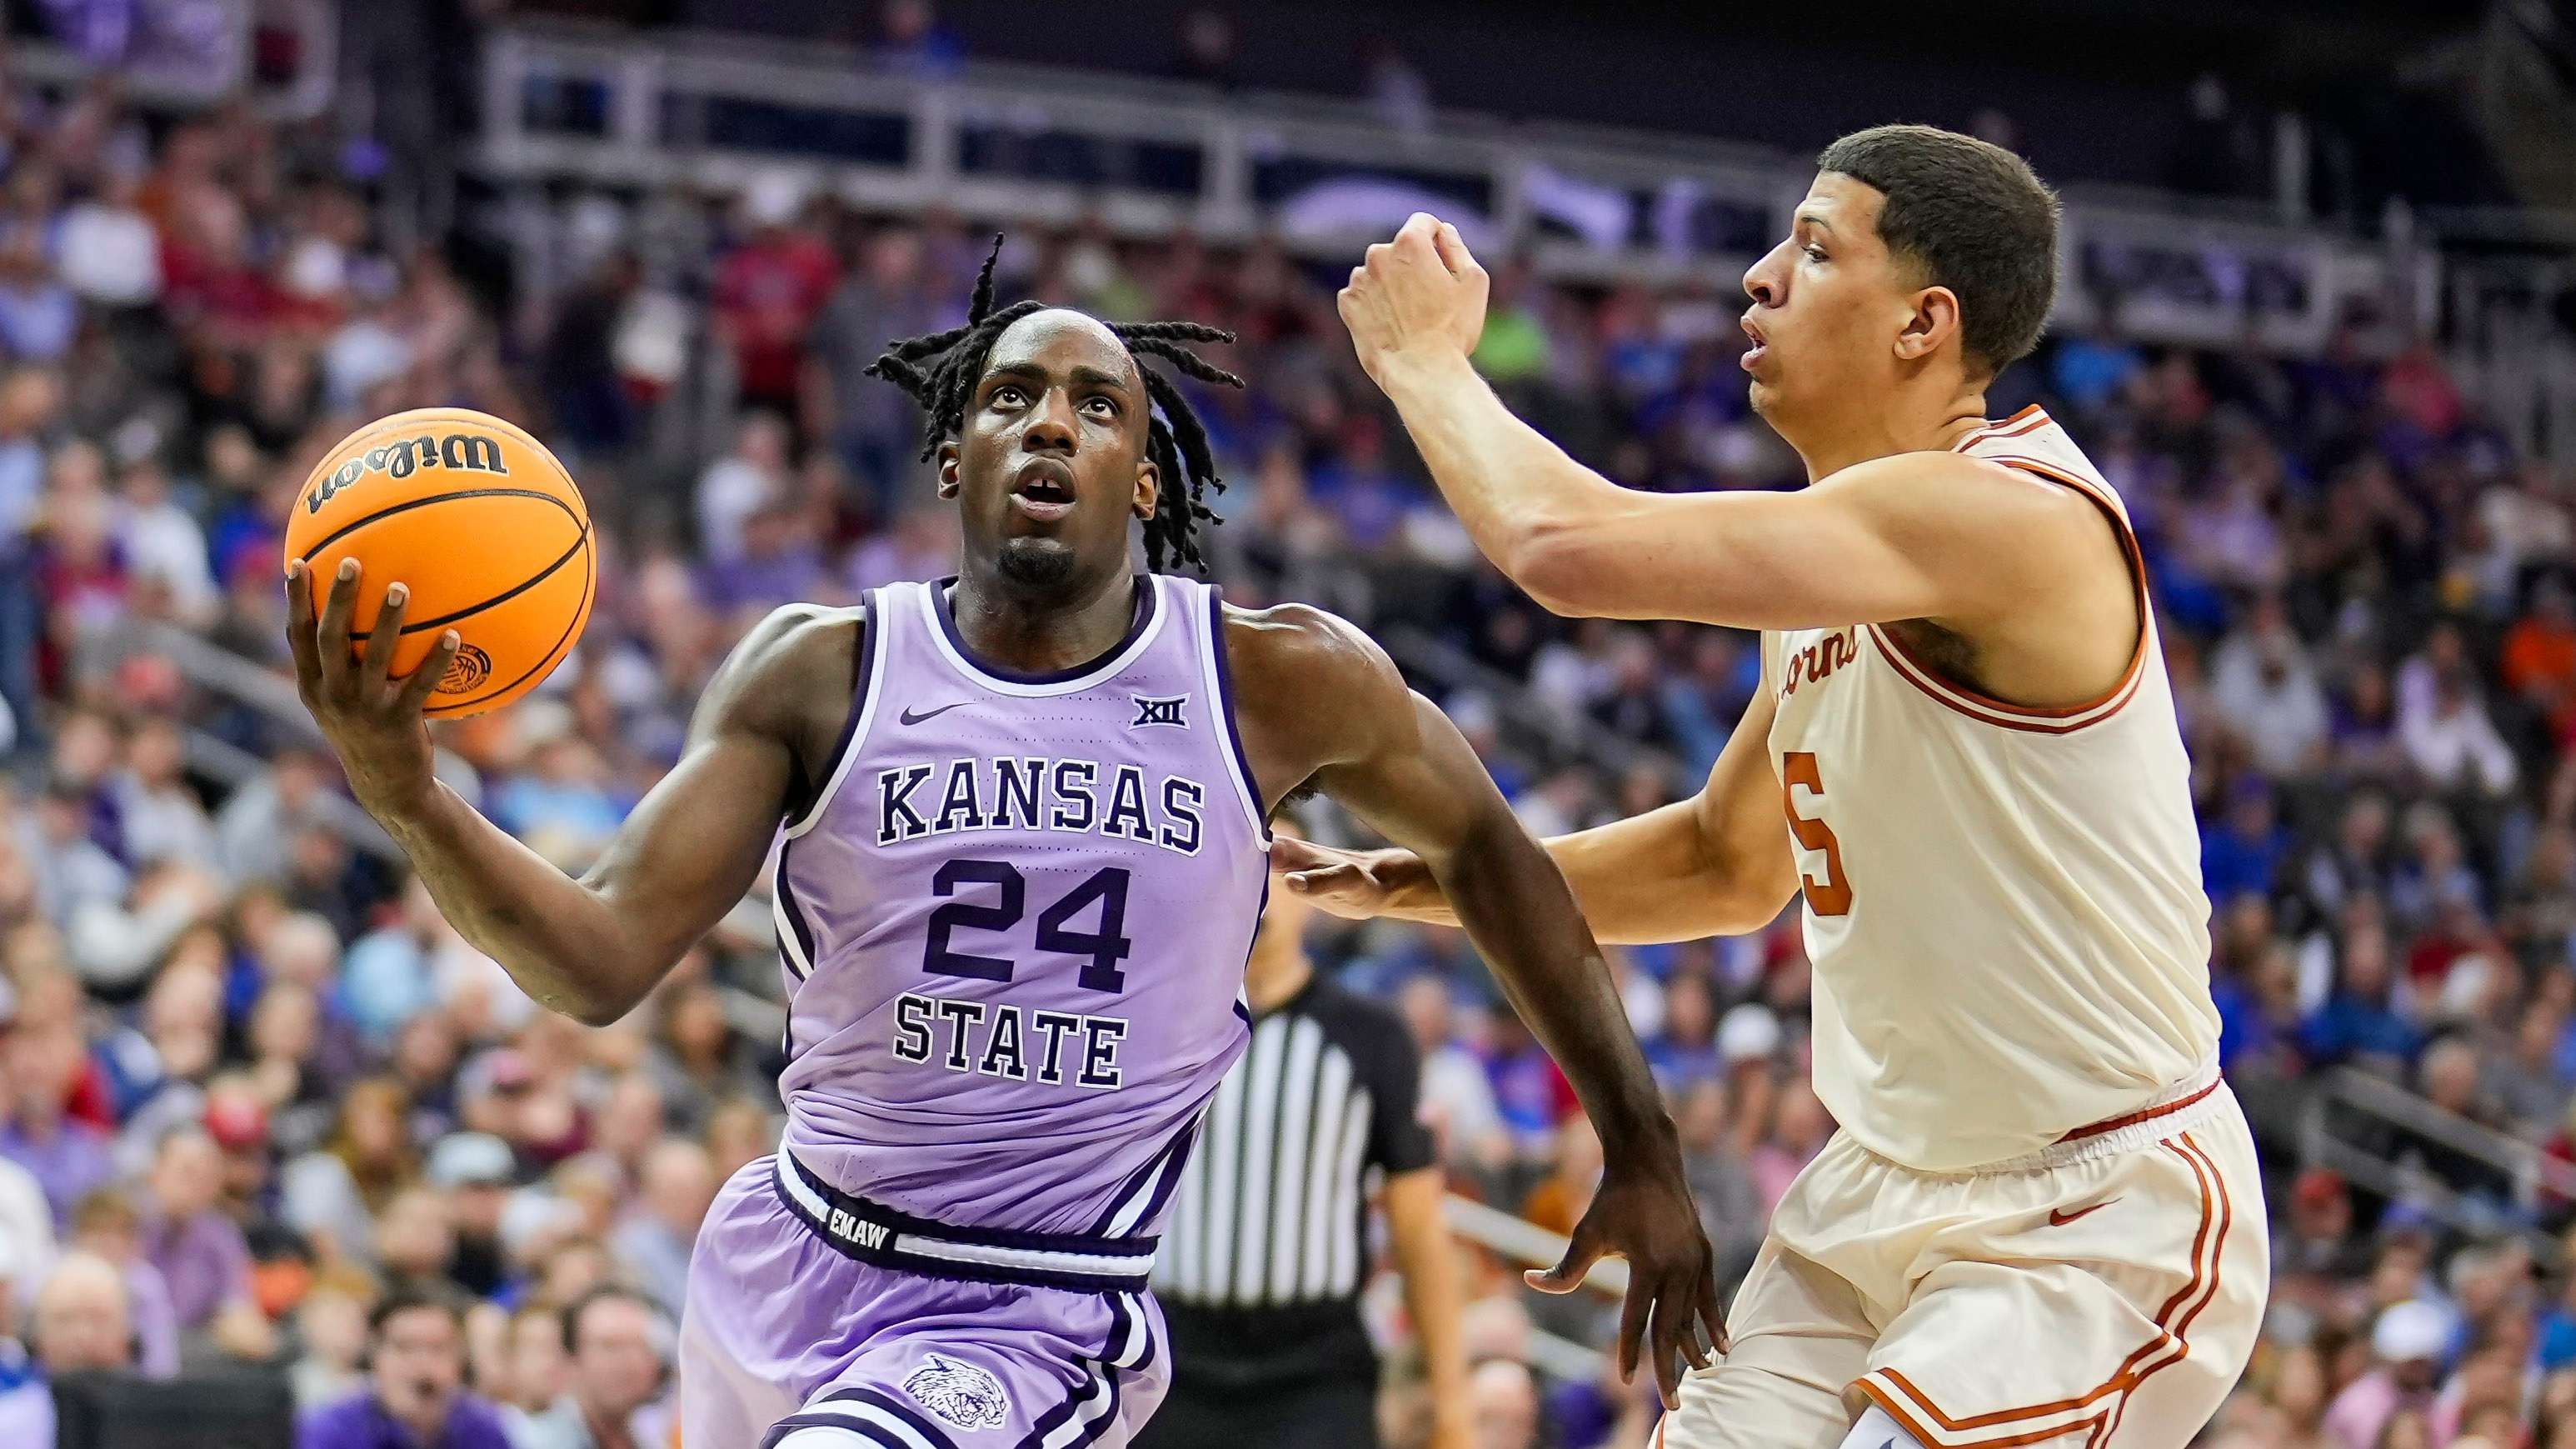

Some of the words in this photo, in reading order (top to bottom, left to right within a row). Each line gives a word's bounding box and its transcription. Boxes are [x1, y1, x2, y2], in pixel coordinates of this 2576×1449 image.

[307, 433, 510, 515] Wilson
[1132, 697, 1187, 727] XII
[877, 757, 1206, 857] KANSAS
[1784, 752, 1853, 917] 5
[922, 859, 1131, 994] 24
[892, 992, 1129, 1090] STATE
[828, 1208, 891, 1250] EMAW
